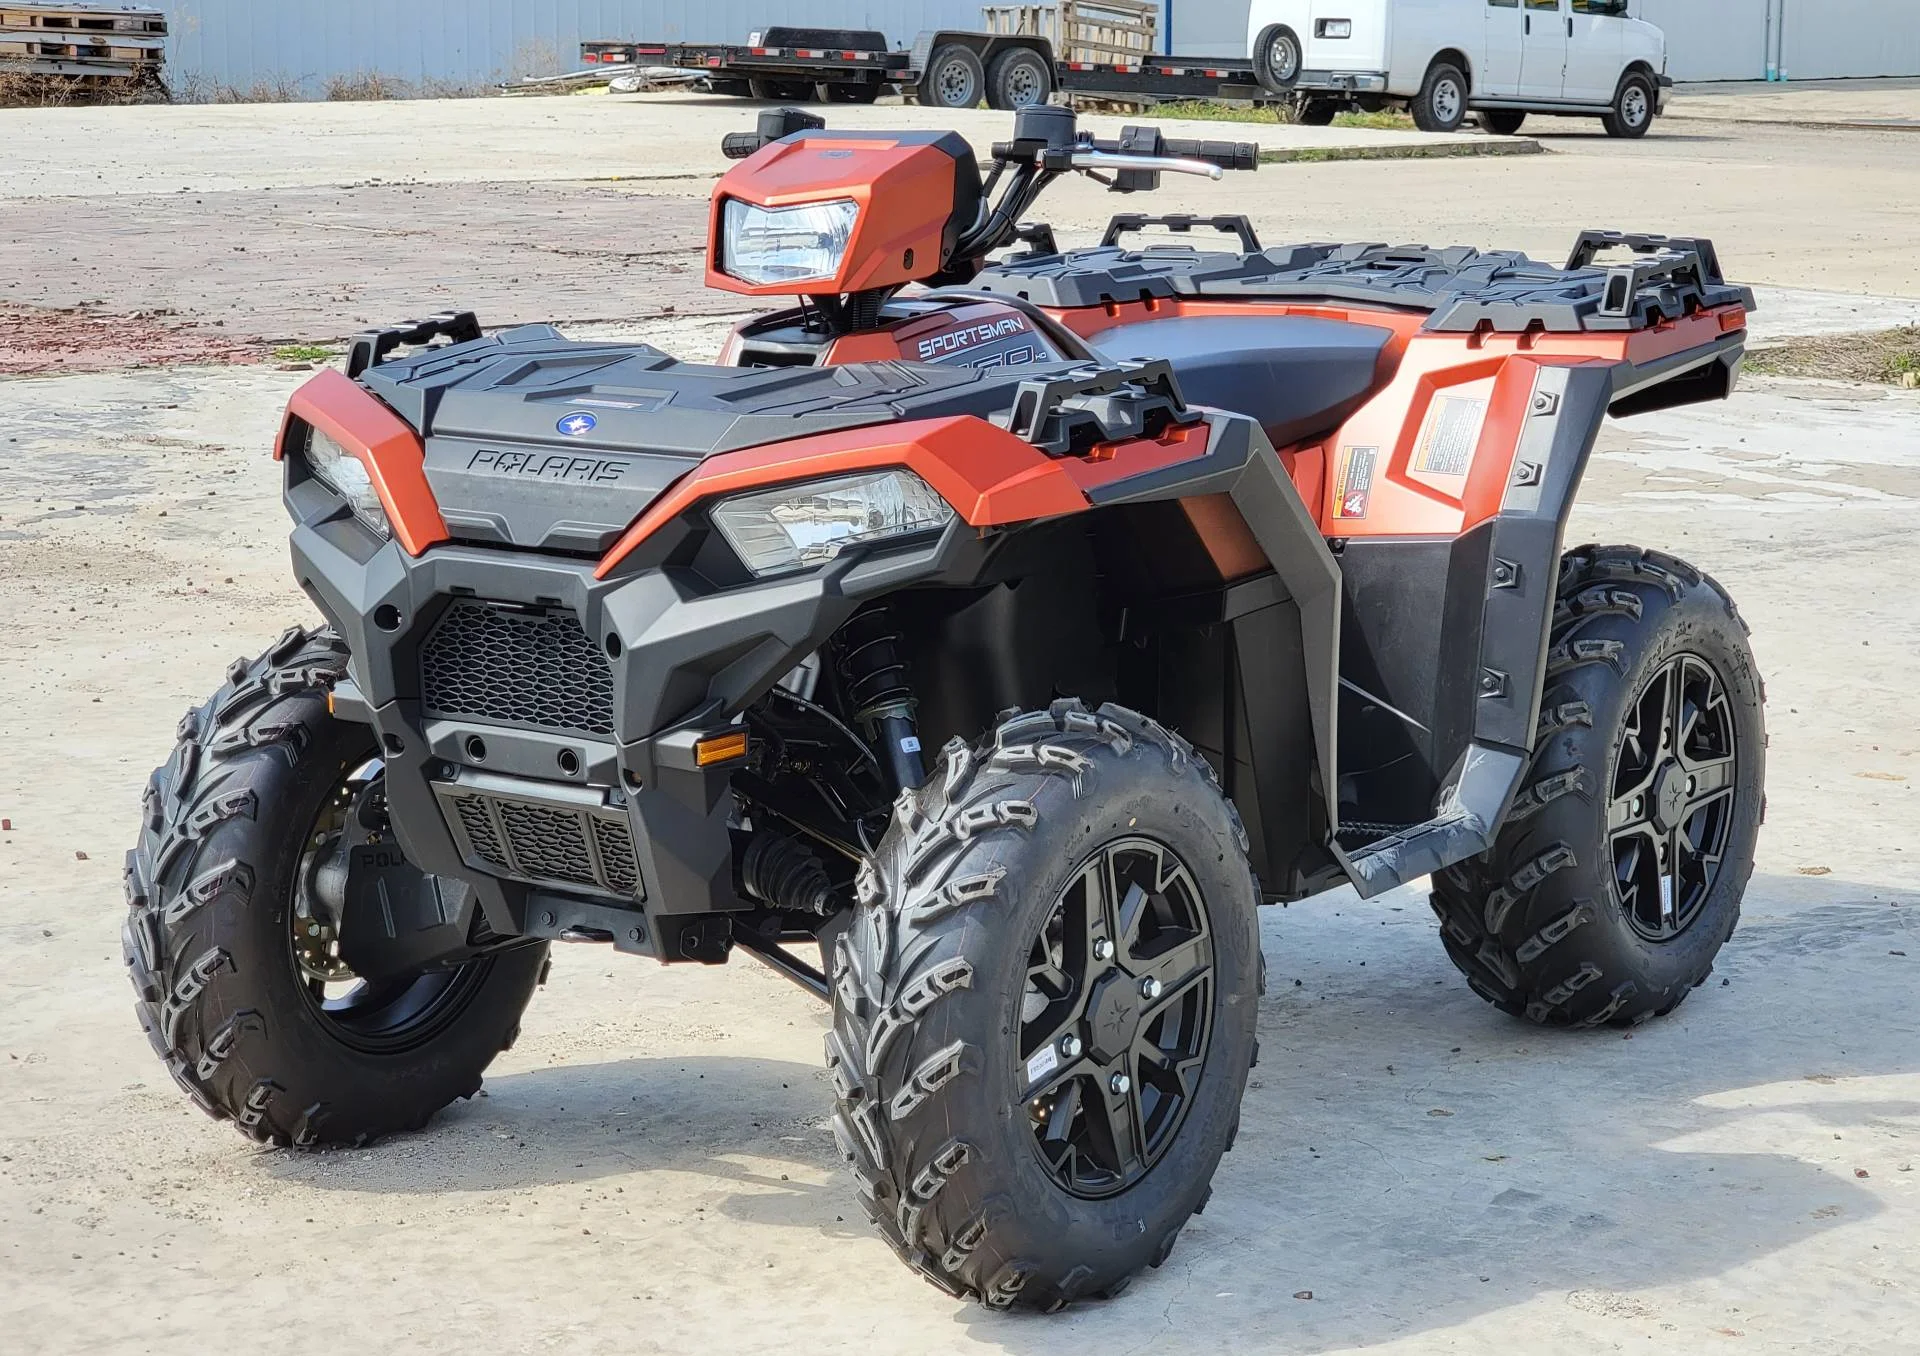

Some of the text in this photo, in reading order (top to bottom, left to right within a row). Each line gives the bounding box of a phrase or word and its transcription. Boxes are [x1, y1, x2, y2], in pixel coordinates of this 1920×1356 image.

[918, 317, 1024, 359] SPORTSMAN
[957, 344, 1034, 369] 50
[467, 449, 632, 481] POLARIS
